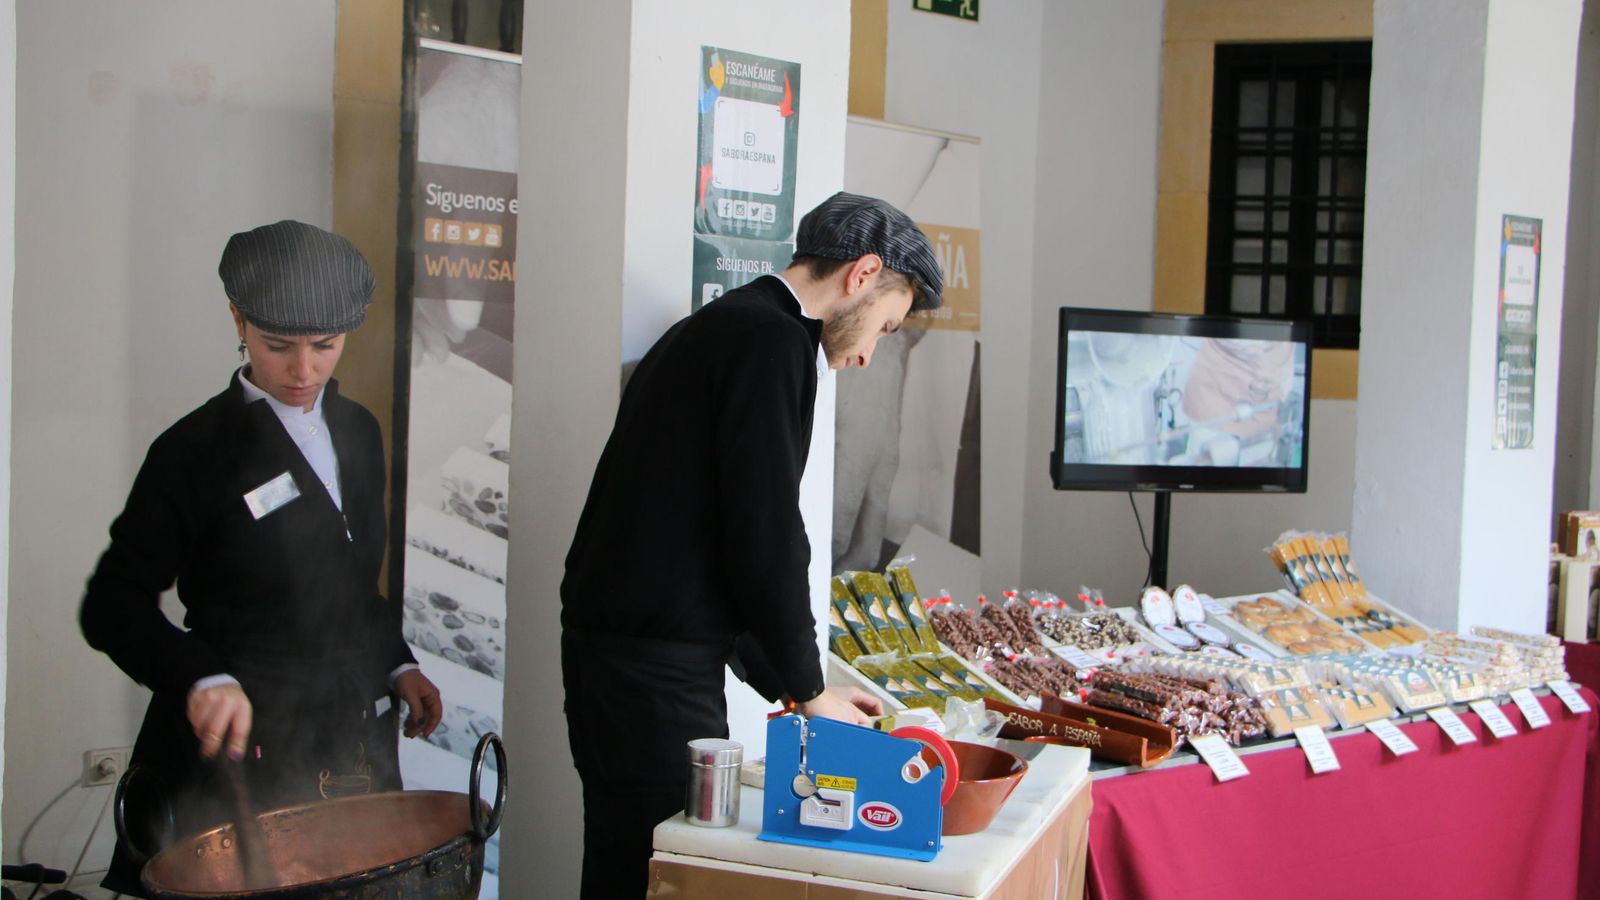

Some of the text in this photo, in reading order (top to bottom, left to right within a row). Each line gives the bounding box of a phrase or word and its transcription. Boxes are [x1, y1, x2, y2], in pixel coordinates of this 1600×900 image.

[726, 61, 776, 82] ESCANÉAME
[426, 183, 505, 213] Síguenos
[424, 254, 517, 282] WWW.SA
[716, 257, 775, 274] SÍGUENOS EN:
[1008, 711, 1102, 748] SABOR A ESPAÑA
[866, 809, 892, 823] Vail
